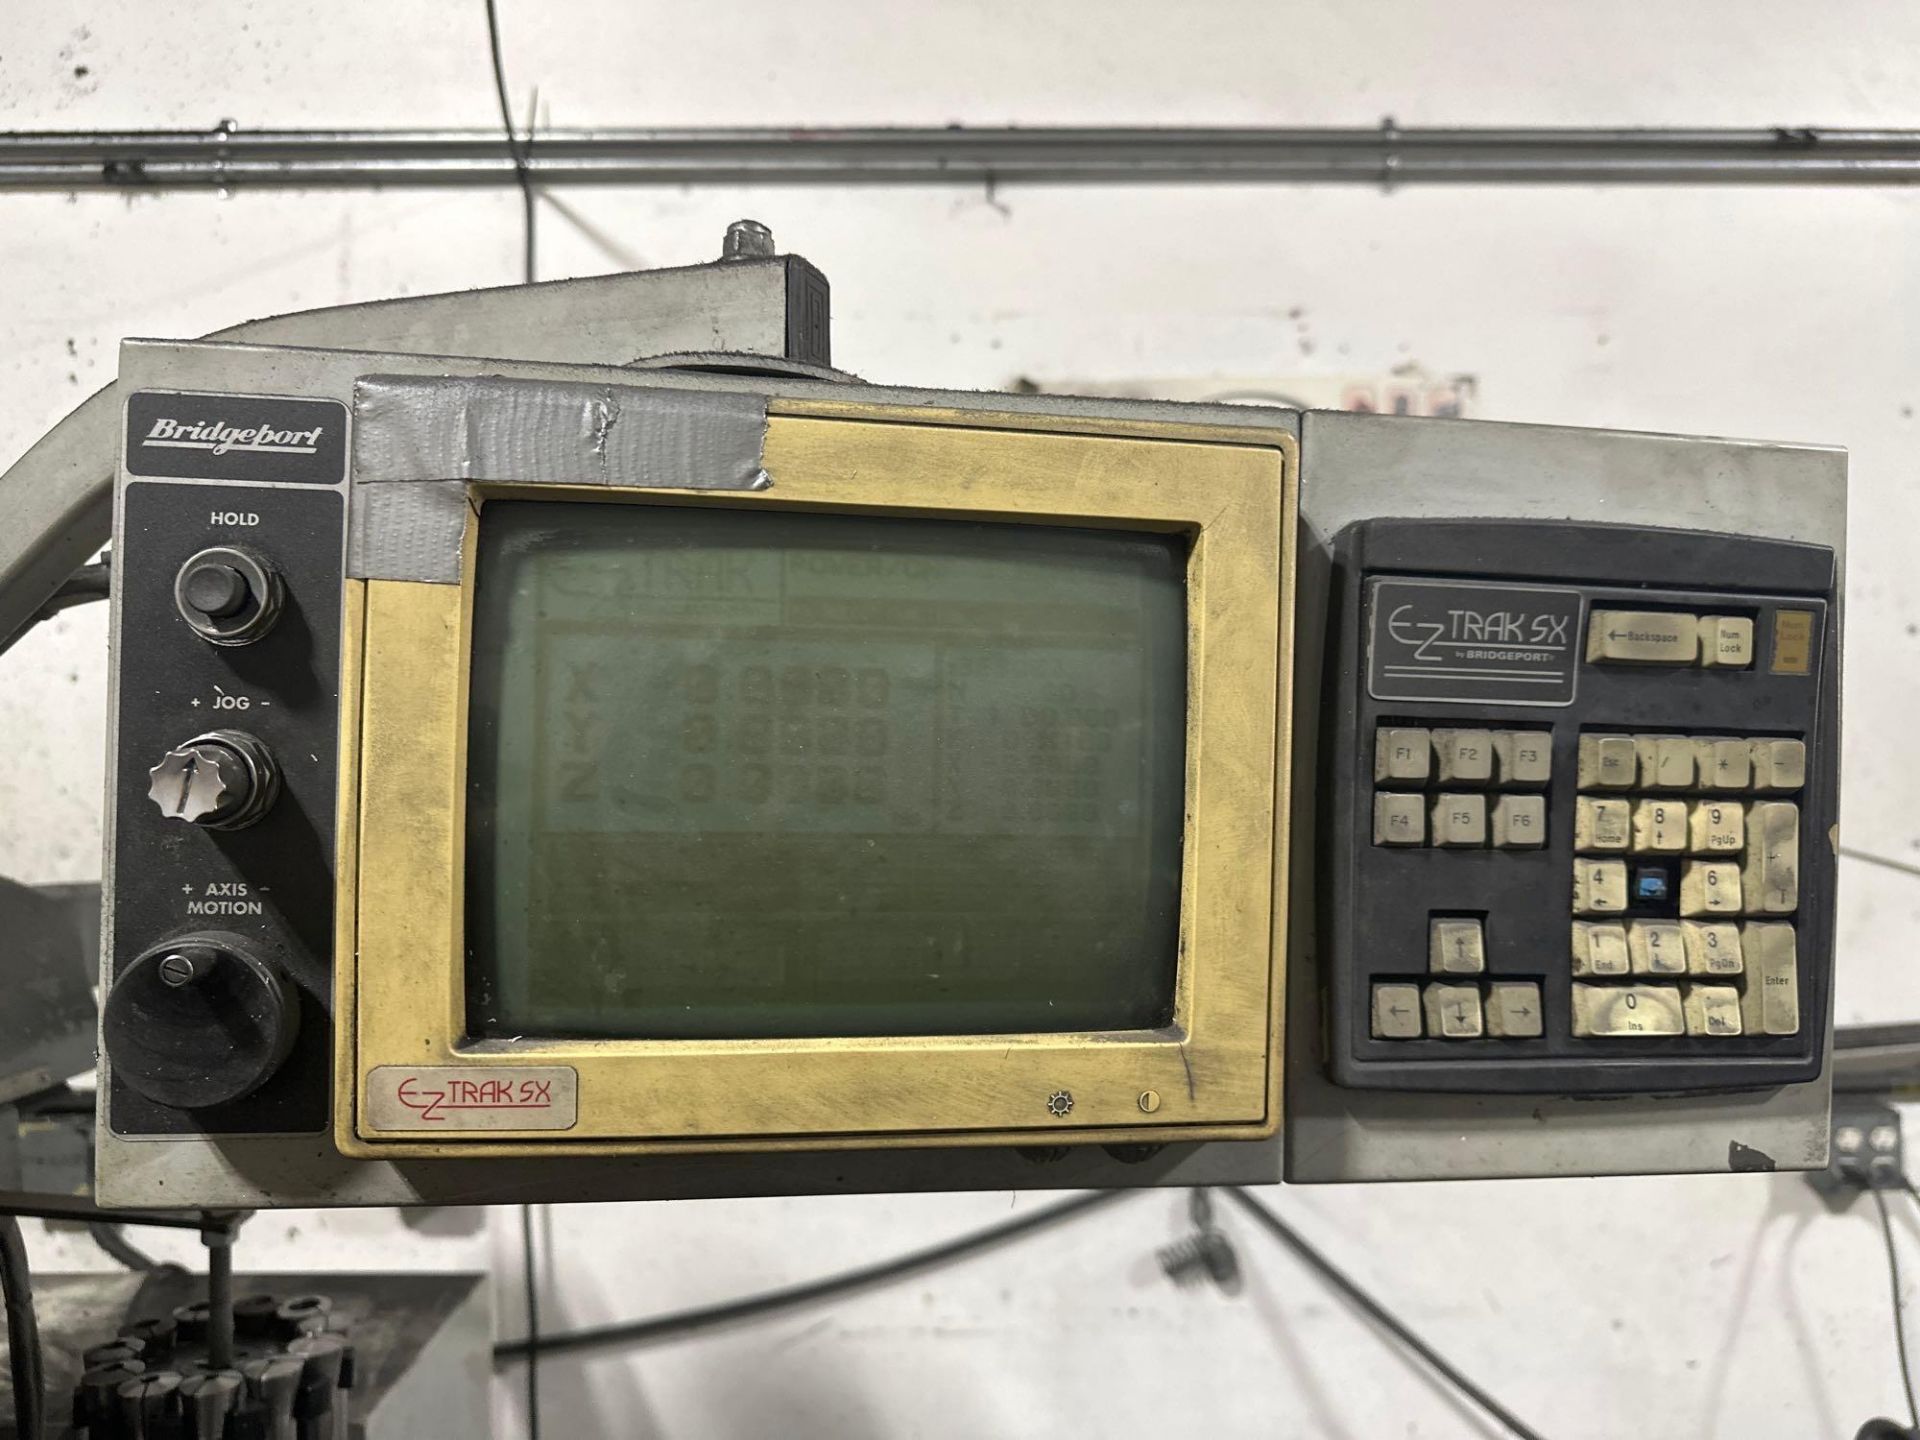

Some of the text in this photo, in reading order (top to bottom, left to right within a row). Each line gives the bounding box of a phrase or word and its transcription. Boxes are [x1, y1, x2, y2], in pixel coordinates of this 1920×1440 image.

[146, 418, 323, 455] Bridgeport
[211, 512, 259, 526] HOLD
[1448, 610, 1525, 642] TRAK
[1530, 614, 1569, 644] SX
[1628, 631, 1678, 643] Backspace
[1720, 630, 1739, 639] Num
[1720, 644, 1741, 653] Lock
[212, 696, 250, 710] JOG
[1396, 748, 1410, 760] F1
[1459, 749, 1478, 760] F2
[1520, 751, 1537, 762] F3
[1453, 813, 1470, 825] F5
[1597, 806, 1606, 821] 7
[1655, 808, 1664, 824] 8
[1711, 809, 1721, 824] 9
[1390, 815, 1408, 827] F4
[1513, 815, 1530, 827] F6
[1711, 835, 1735, 846] PgUp
[1593, 869, 1603, 885] 4
[1708, 870, 1718, 886] 6
[205, 883, 247, 896] AXIS
[187, 902, 262, 915] MOTION
[1594, 934, 1600, 948] 1
[1651, 932, 1660, 947] 2
[1708, 932, 1718, 948] 3
[1765, 976, 1789, 985] Enter
[1626, 993, 1636, 1010] 0
[1628, 1021, 1643, 1031] Ins
[448, 1080, 513, 1103] TRAK
[520, 1081, 551, 1103] SX
